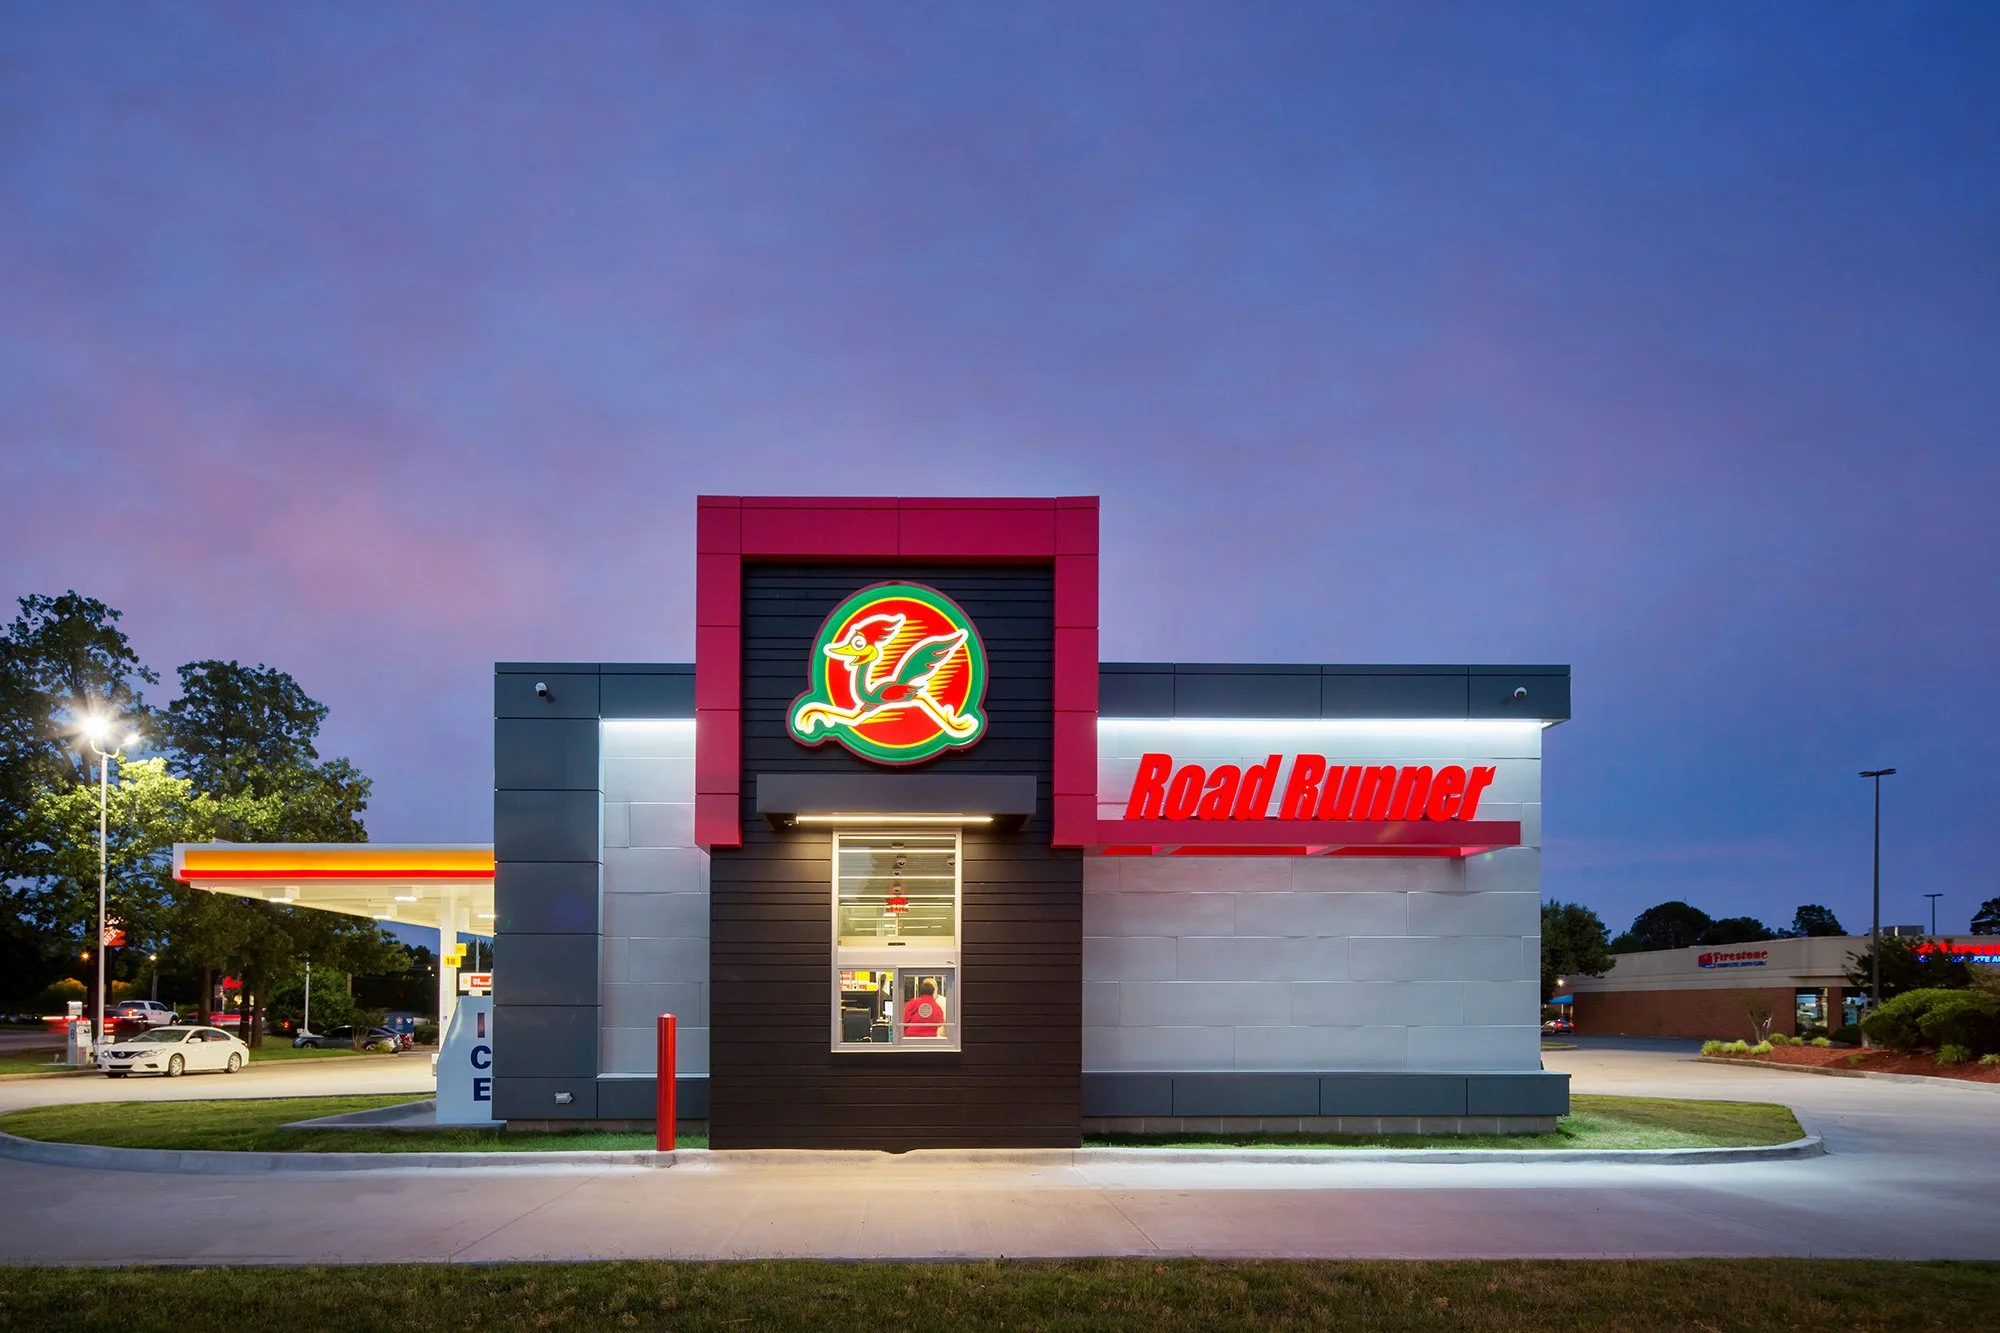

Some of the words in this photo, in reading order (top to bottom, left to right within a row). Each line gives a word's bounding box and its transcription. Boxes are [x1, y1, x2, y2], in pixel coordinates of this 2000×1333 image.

[1124, 753, 1283, 820] Road
[1279, 753, 1497, 820] Runner
[1713, 950, 1768, 963] Firestone
[470, 1012, 492, 1101] ICE
